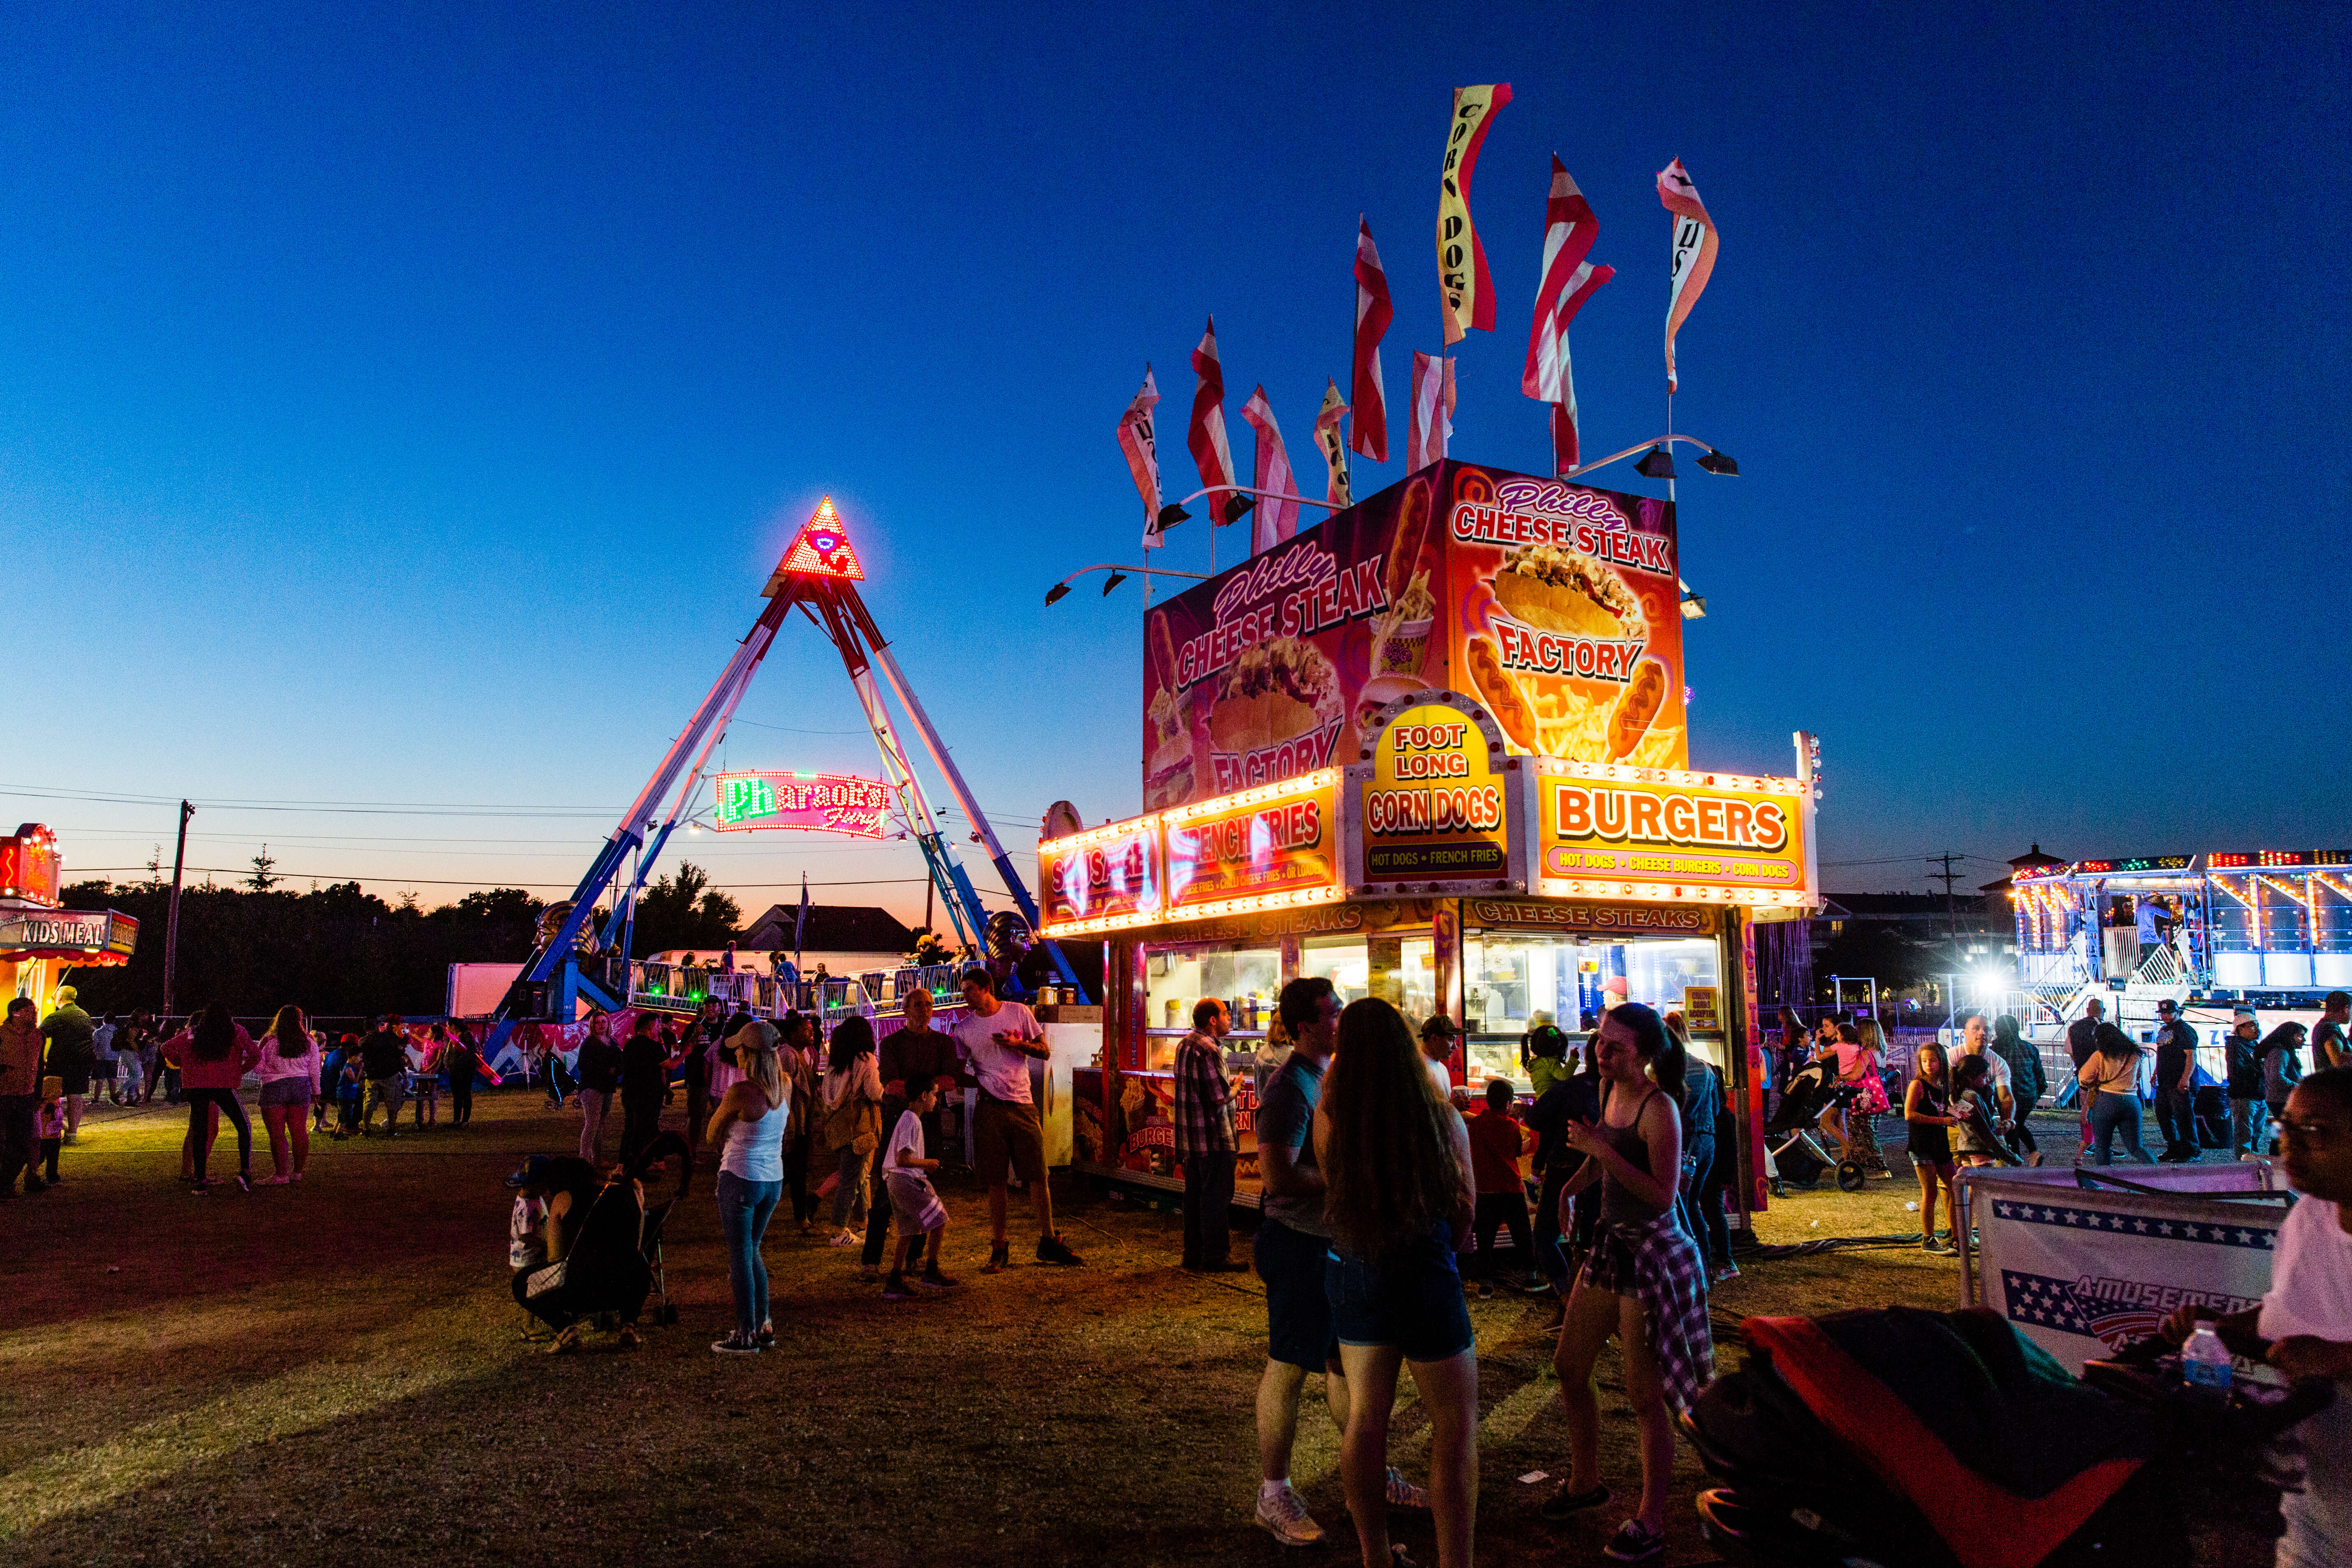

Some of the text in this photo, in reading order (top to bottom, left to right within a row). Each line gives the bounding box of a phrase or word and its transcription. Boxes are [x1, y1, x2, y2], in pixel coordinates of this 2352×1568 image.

[1444, 215, 1466, 313] DOGS
[1498, 482, 1627, 531] Philly
[1453, 504, 1671, 573] CHEESE STEAK
[1212, 540, 1337, 628] Philly
[1177, 554, 1389, 690] CHEESE STEAK
[1491, 617, 1644, 681] FACTORY
[1393, 723, 1467, 750] FOOT
[1211, 716, 1342, 794] FACTORY
[1394, 752, 1468, 779] LONG
[1367, 785, 1500, 834] CORN DOGS
[1555, 784, 1787, 851] BURGERS
[1372, 849, 1498, 866] HOT DOGS FRENCH FRIES
[1560, 852, 1789, 878] HOT DOGS CHEESE BURGERS CORN DOGS
[1180, 883, 1198, 896] HEESE
[1199, 880, 1214, 894] FRIES
[1240, 873, 1262, 887] CHEESE
[1263, 869, 1280, 883] FRIES
[1287, 866, 1297, 879] OR
[1298, 862, 1323, 876] LOADED
[0, 913, 27, 928] pecial
[1260, 905, 1362, 936] STEAKS
[1476, 902, 1699, 928] CHEESE STEAKS
[22, 921, 60, 944] KIDS
[62, 922, 103, 945] MEAL
[1130, 1126, 1175, 1153] BURGE
